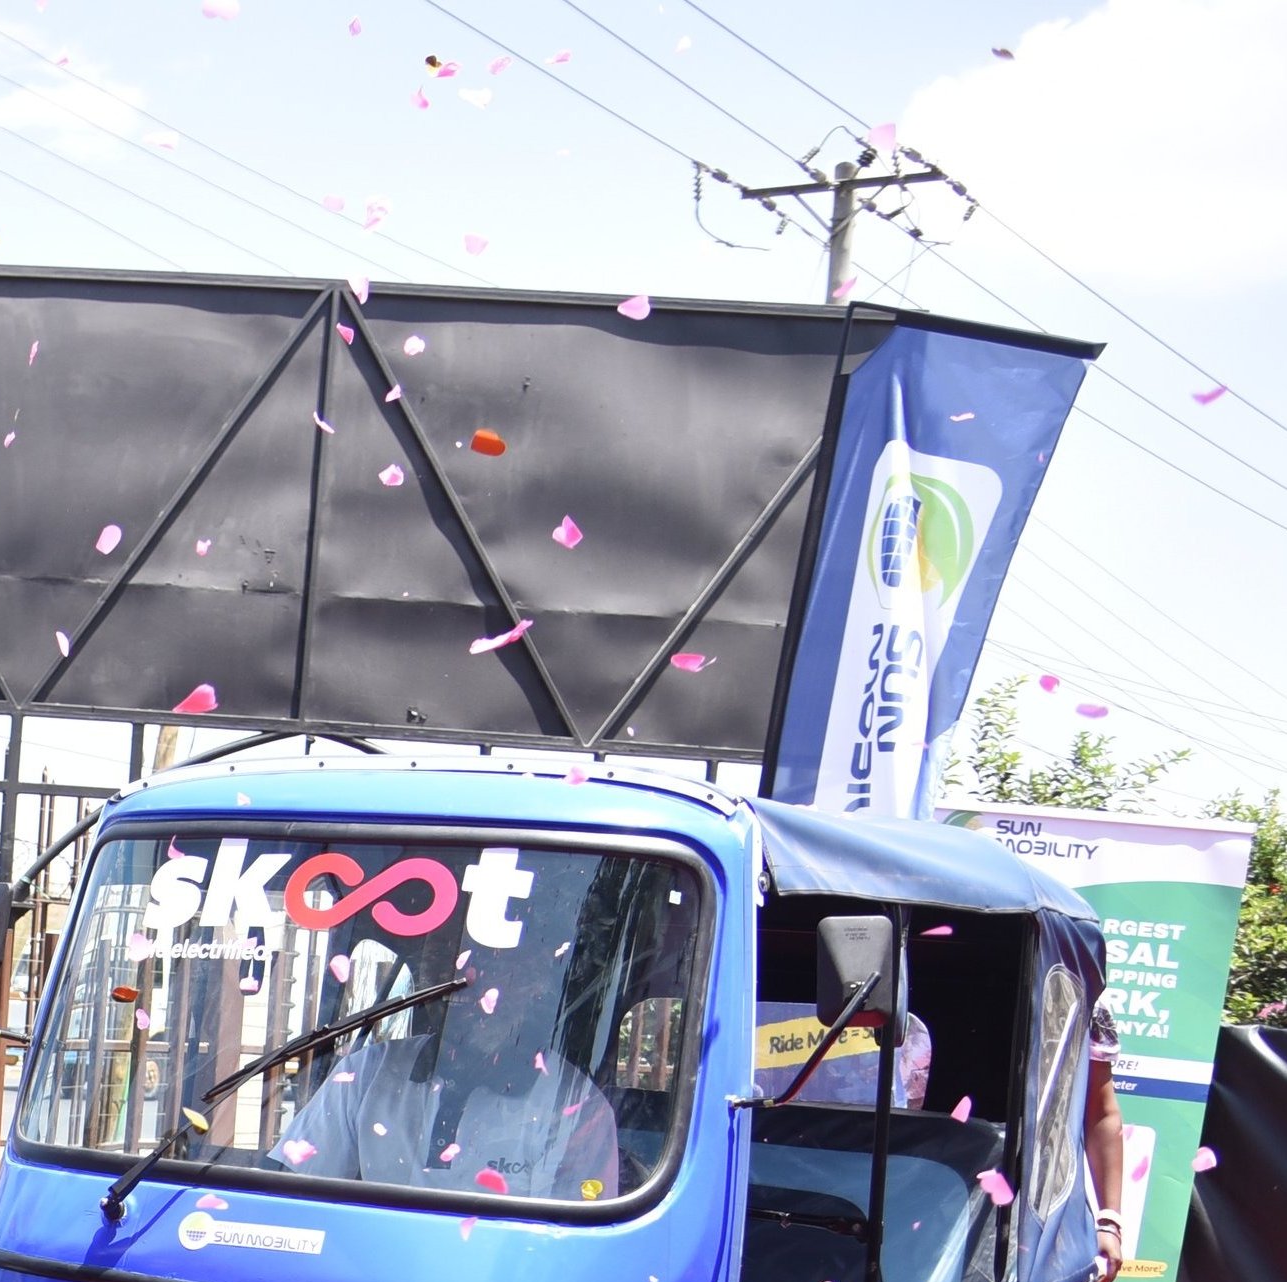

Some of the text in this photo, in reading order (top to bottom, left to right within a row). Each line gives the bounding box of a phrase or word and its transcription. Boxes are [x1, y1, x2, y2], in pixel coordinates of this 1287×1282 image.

[877, 624, 923, 752] SUN
[995, 819, 1042, 837] SUN
[1103, 918, 1187, 941] RGEST
[1109, 967, 1177, 989] PPING
[769, 1035, 804, 1055] Ride
[213, 1230, 320, 1252] SUN MOBILITY
